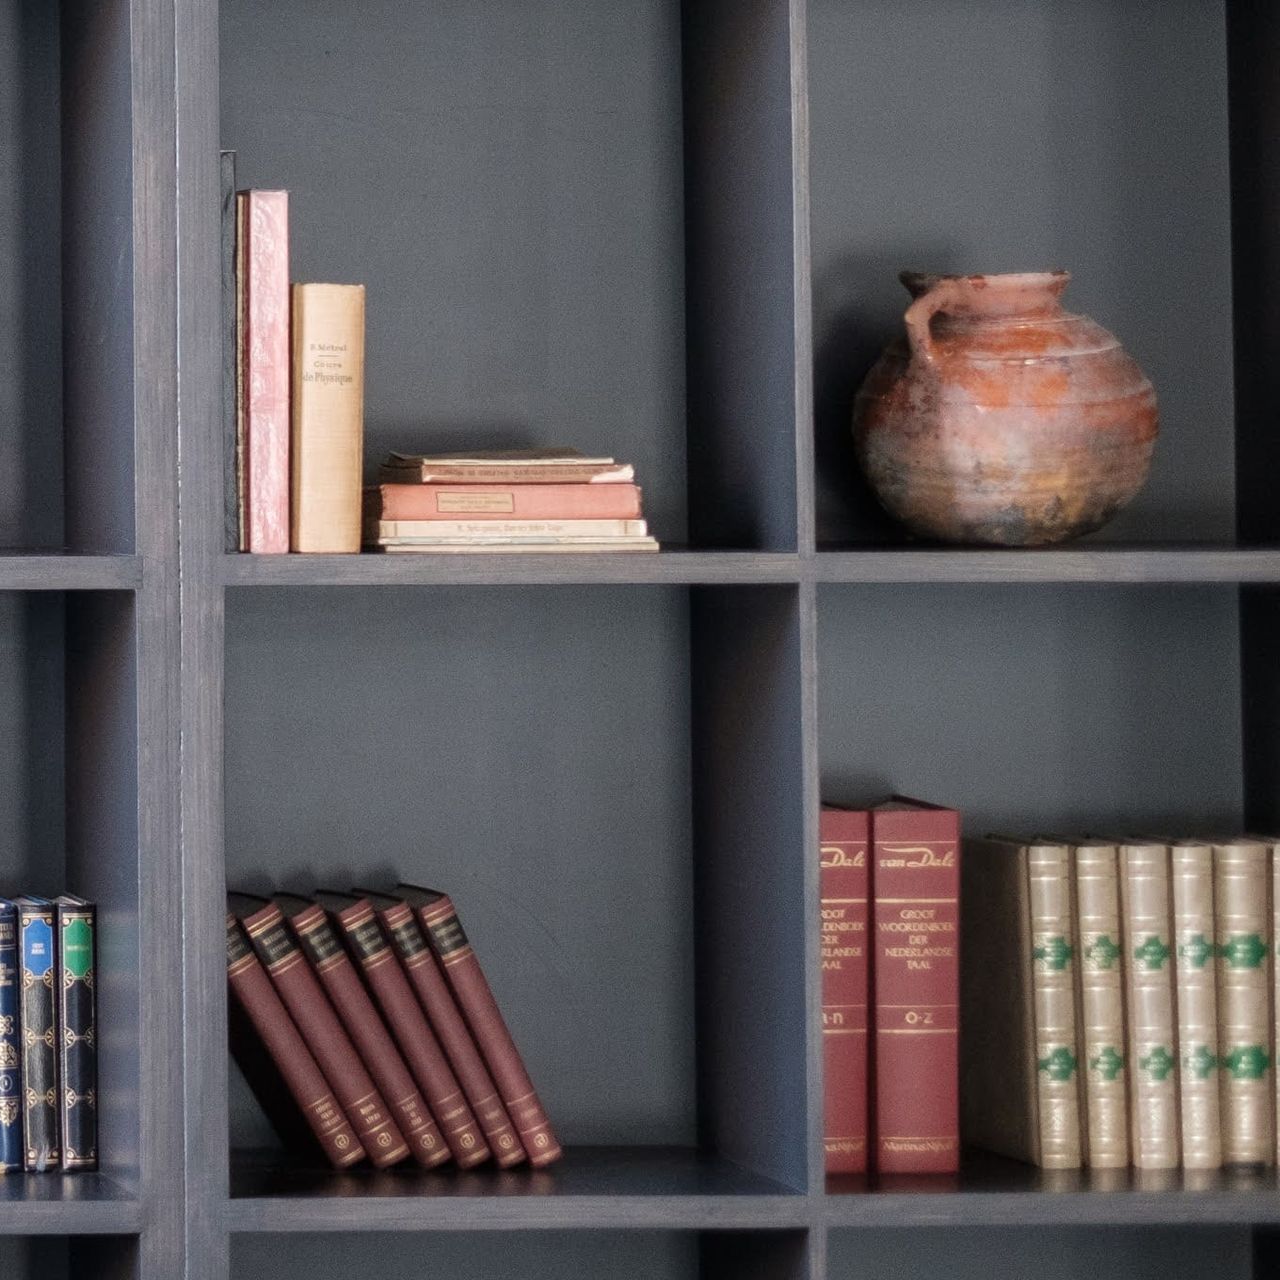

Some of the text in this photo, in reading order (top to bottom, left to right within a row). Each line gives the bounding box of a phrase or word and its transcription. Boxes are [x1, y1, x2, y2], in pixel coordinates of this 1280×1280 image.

[315, 372, 352, 385] Physique
[883, 847, 954, 867] Dale
[900, 910, 935, 919] GROOT
[909, 935, 928, 944] DER
[885, 948, 955, 956] NEDERLANDSE
[907, 960, 931, 969] TAAL
